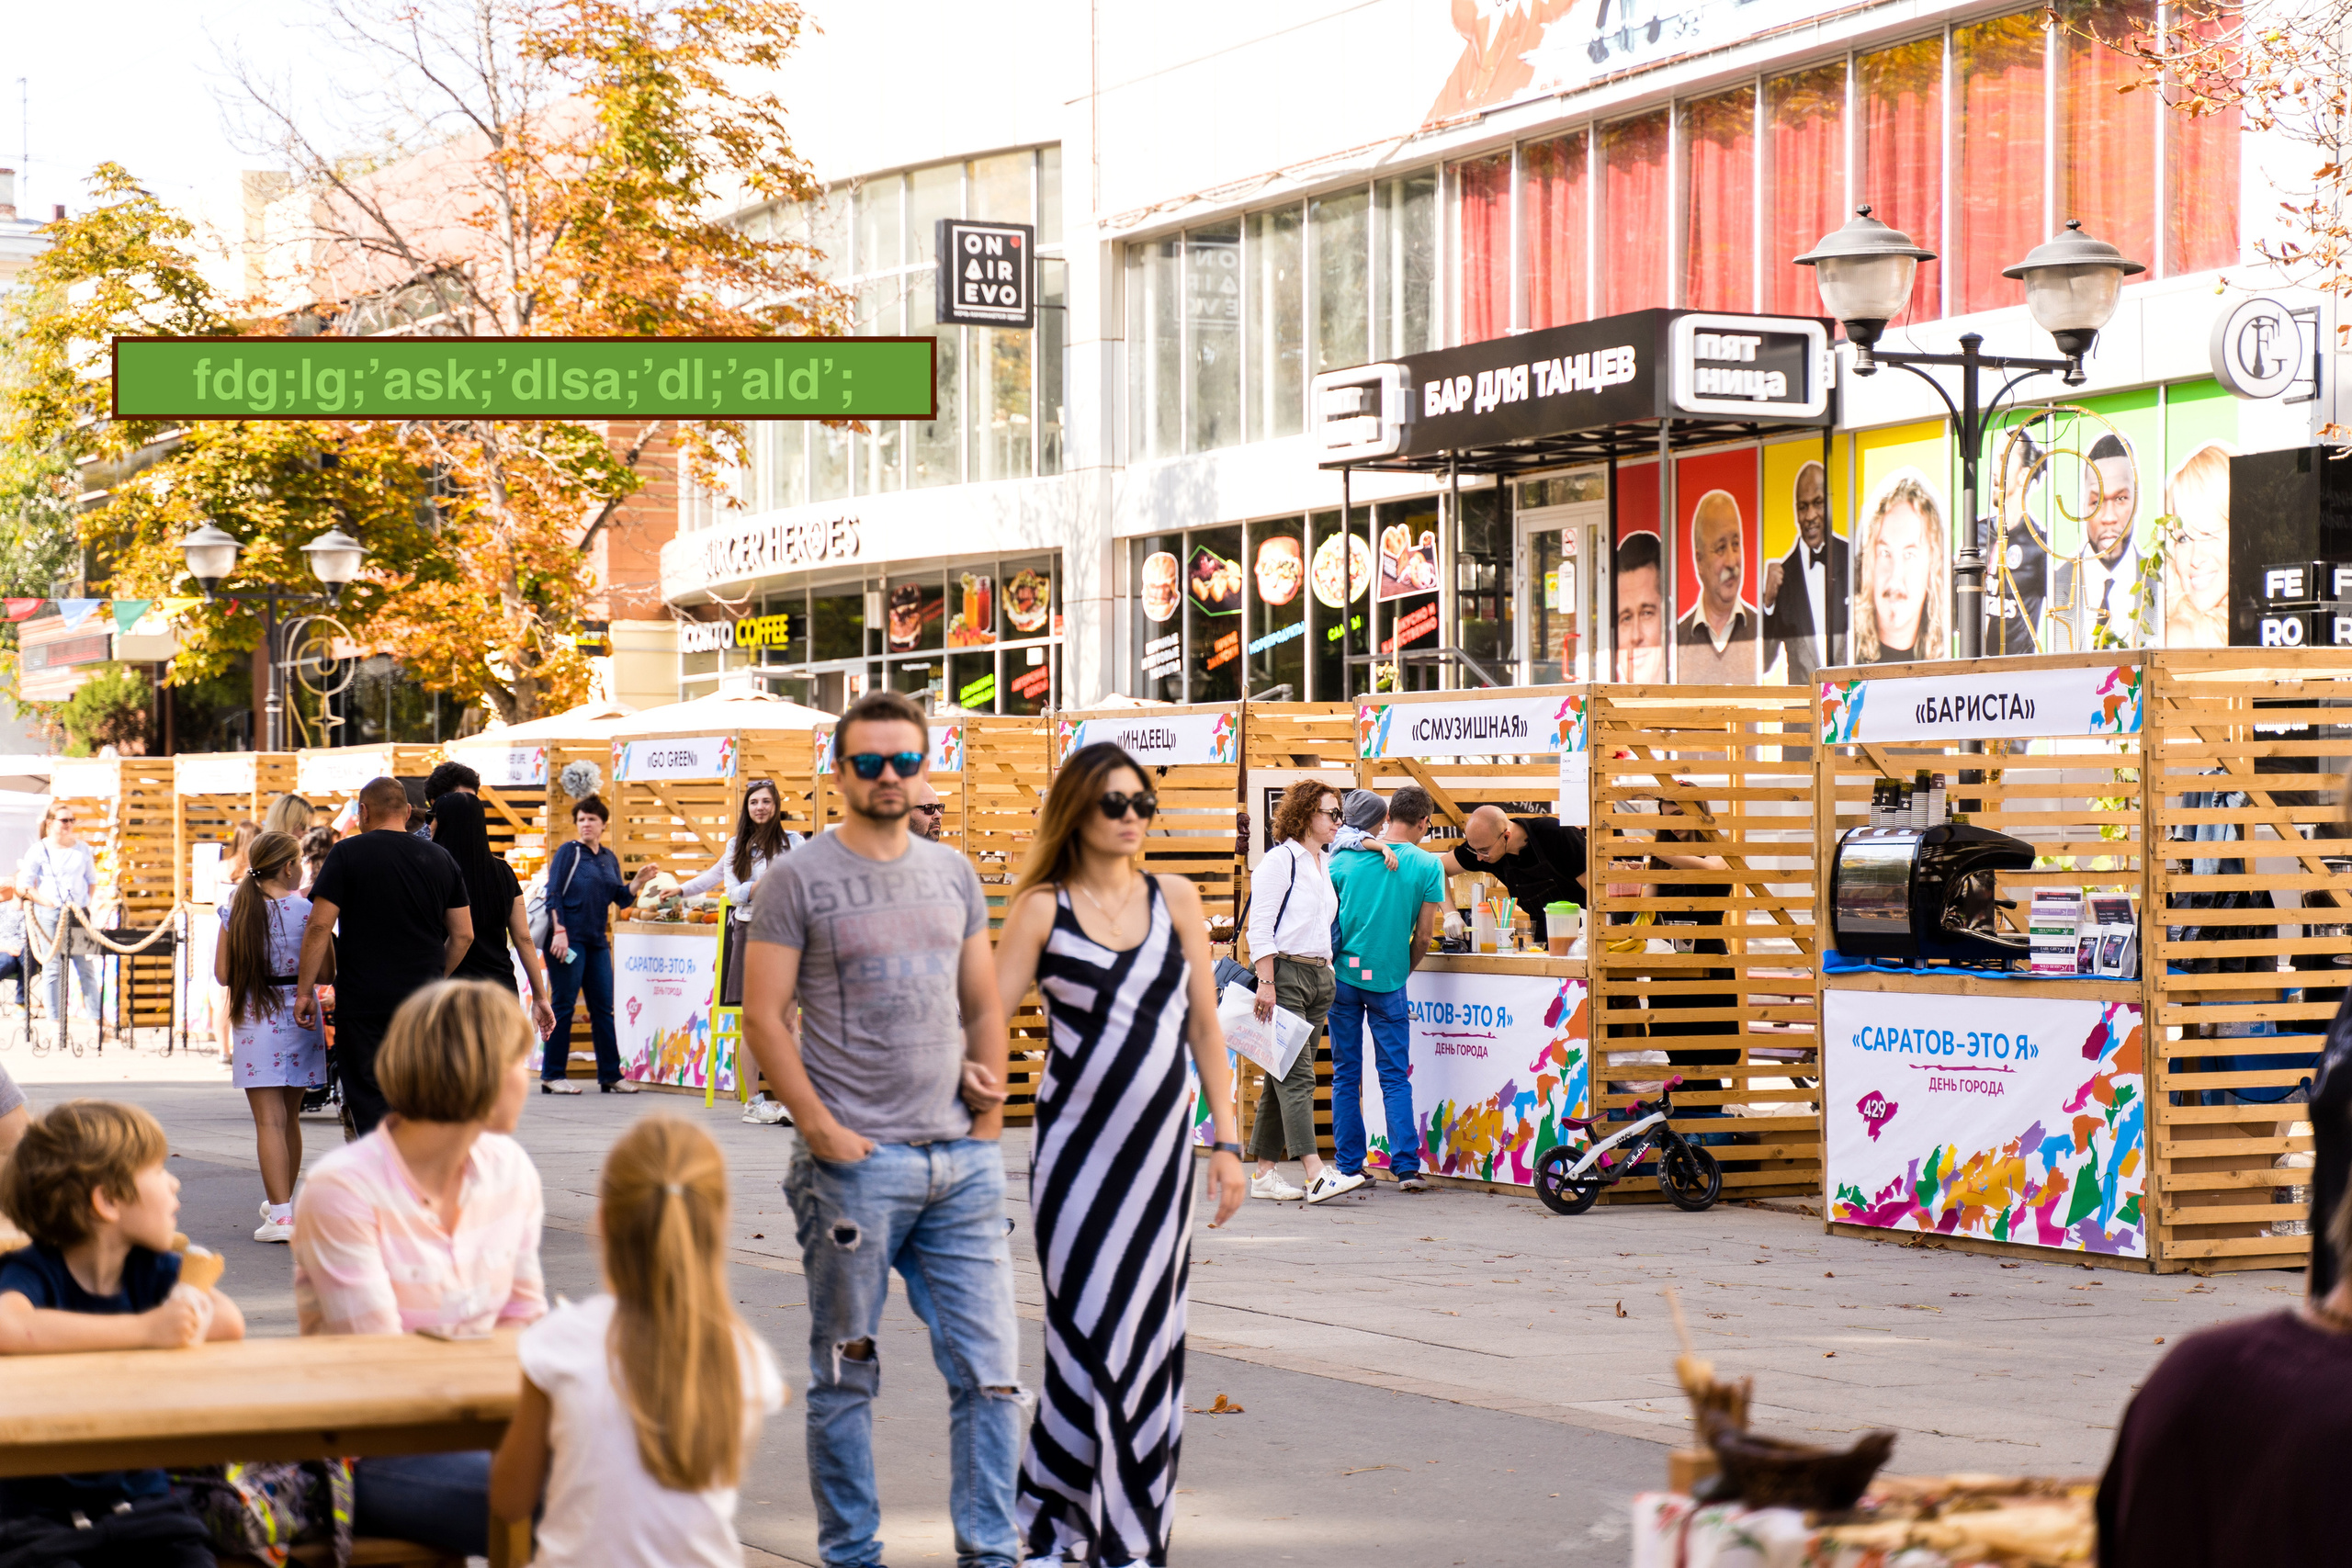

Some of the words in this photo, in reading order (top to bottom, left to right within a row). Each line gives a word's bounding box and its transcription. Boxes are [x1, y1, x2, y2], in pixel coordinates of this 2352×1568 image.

[965, 233, 1002, 256] ON
[965, 258, 1013, 281] AIR
[965, 282, 1017, 305] EVO
[1424, 375, 1473, 417] БАР
[1474, 364, 1529, 414] ДЛЯ
[1532, 344, 1636, 398] ТАНЦЕВ
[772, 514, 861, 564] HEROES
[2266, 569, 2303, 599] FE
[735, 614, 789, 648] COFFEE
[2261, 617, 2303, 647] RO
[1916, 694, 2035, 724] «БАРИСТА»
[1412, 715, 1527, 740] «СМУЗИШНАЯ»
[1117, 728, 1177, 752] «ИНДЕЕЦ»
[667, 749, 698, 767] GREEN»
[1496, 1007, 1513, 1028] Я»
[1434, 1042, 1456, 1056] ДЕНЬ
[1456, 1043, 1489, 1060] ГОРОДА
[1852, 1026, 2010, 1059] «САРАТОВ-ЭТО
[2014, 1034, 2040, 1060] Я»
[1928, 1077, 1958, 1093] ДЕНЬ
[1959, 1078, 2005, 1098] ГОРОДА
[1863, 1100, 1887, 1119] 429
